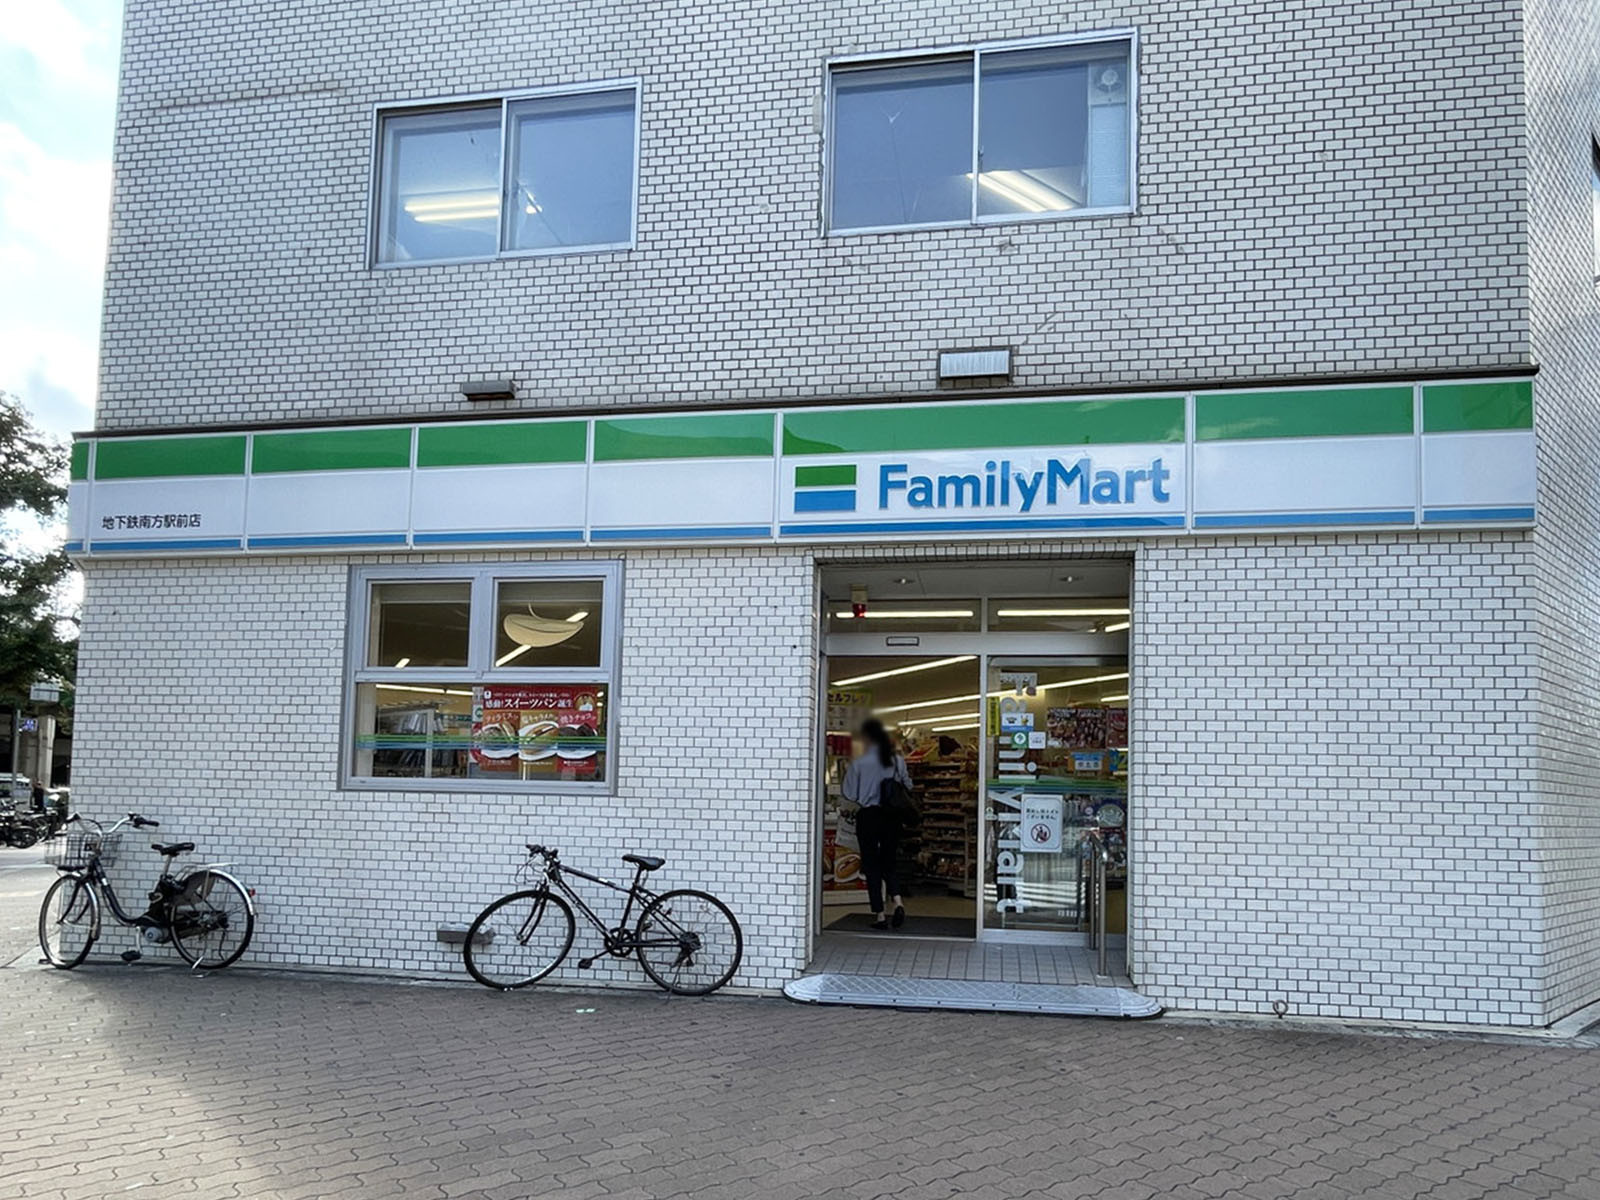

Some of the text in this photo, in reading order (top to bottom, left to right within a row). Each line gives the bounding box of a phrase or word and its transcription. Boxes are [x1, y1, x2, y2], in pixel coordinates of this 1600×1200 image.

[879, 458, 1171, 513] FamilyMart
[101, 513, 201, 530] 地下鉄南方駅前店
